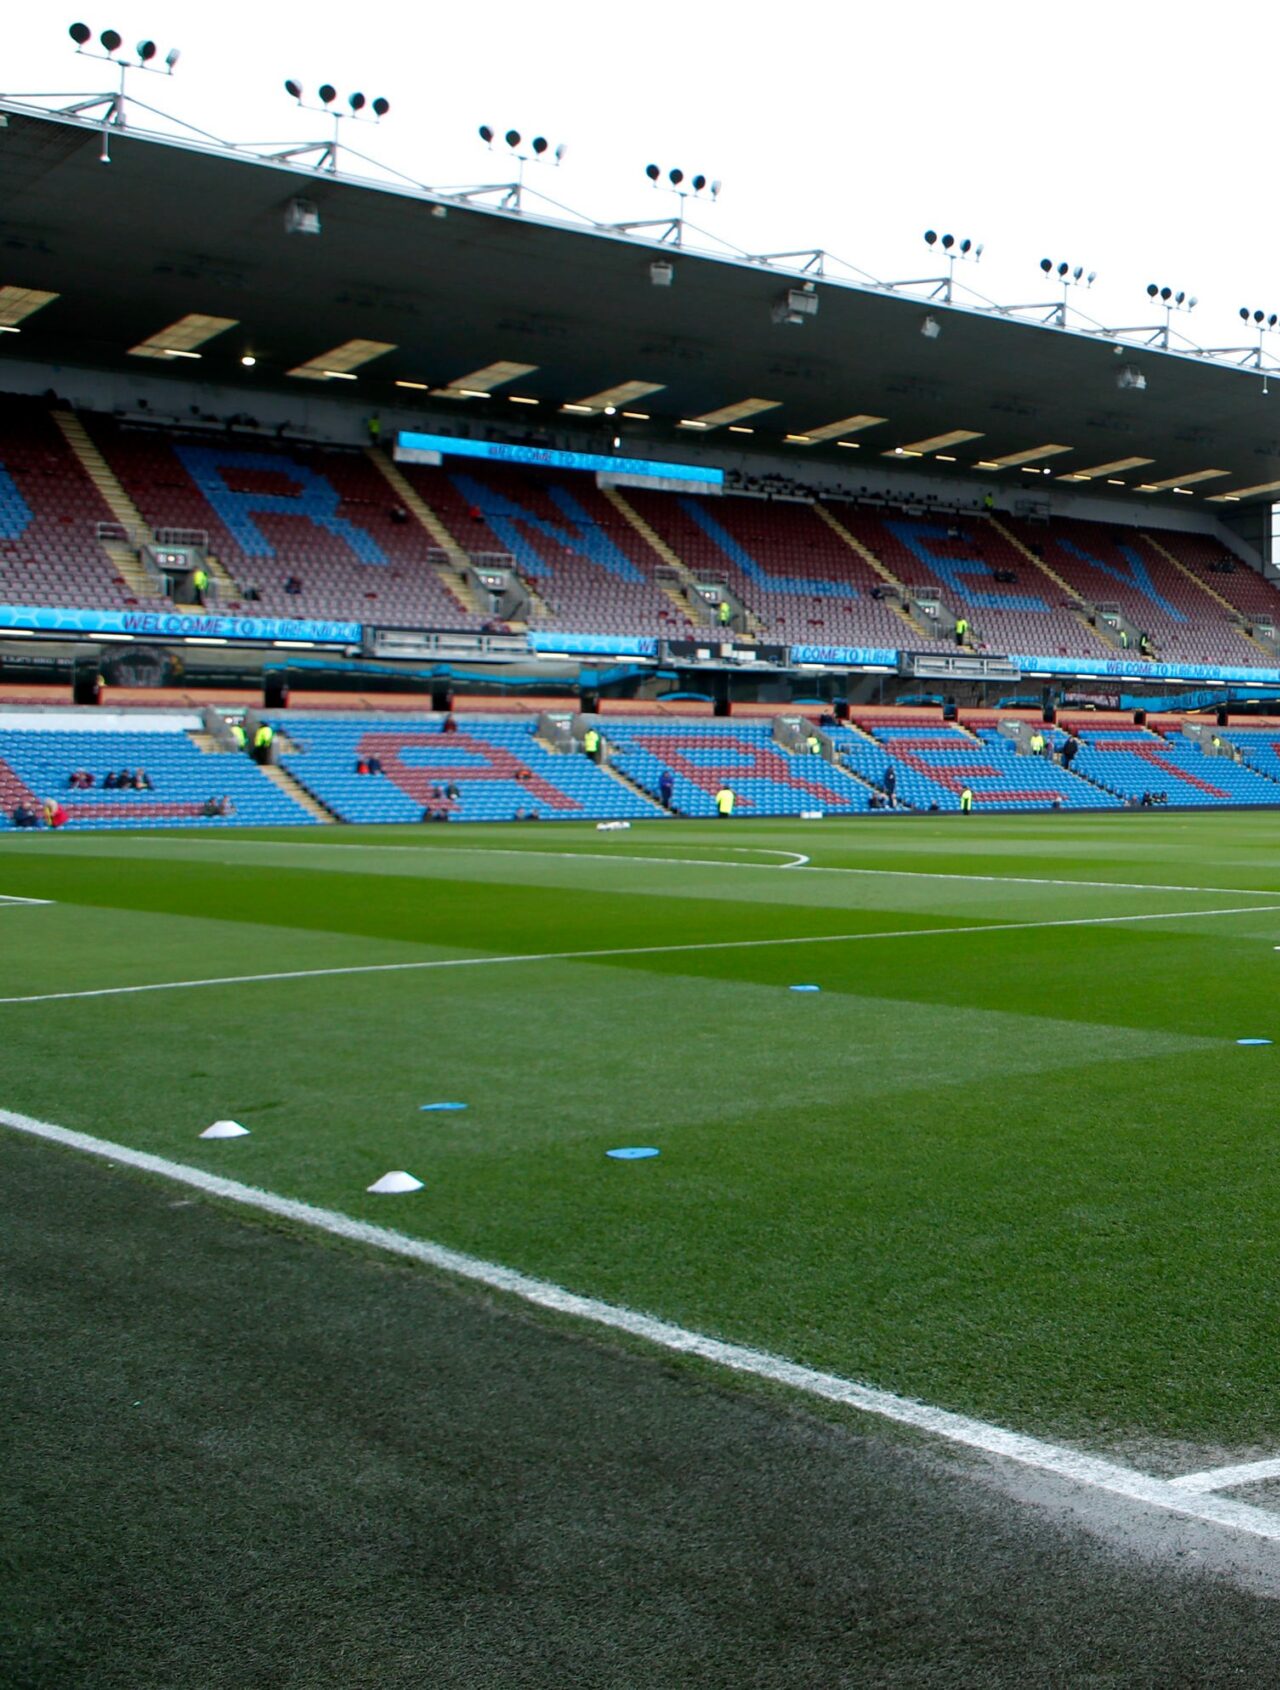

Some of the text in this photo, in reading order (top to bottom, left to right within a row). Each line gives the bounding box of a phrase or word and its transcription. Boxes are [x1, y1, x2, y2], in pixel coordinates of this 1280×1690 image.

[123, 613, 223, 634] WELCOME
[231, 618, 255, 635] TO
[261, 620, 303, 636] TURF
[842, 648, 859, 663] TO
[861, 648, 891, 664] TURF
[1106, 661, 1222, 677] WELCOME TO TURF MOOR
